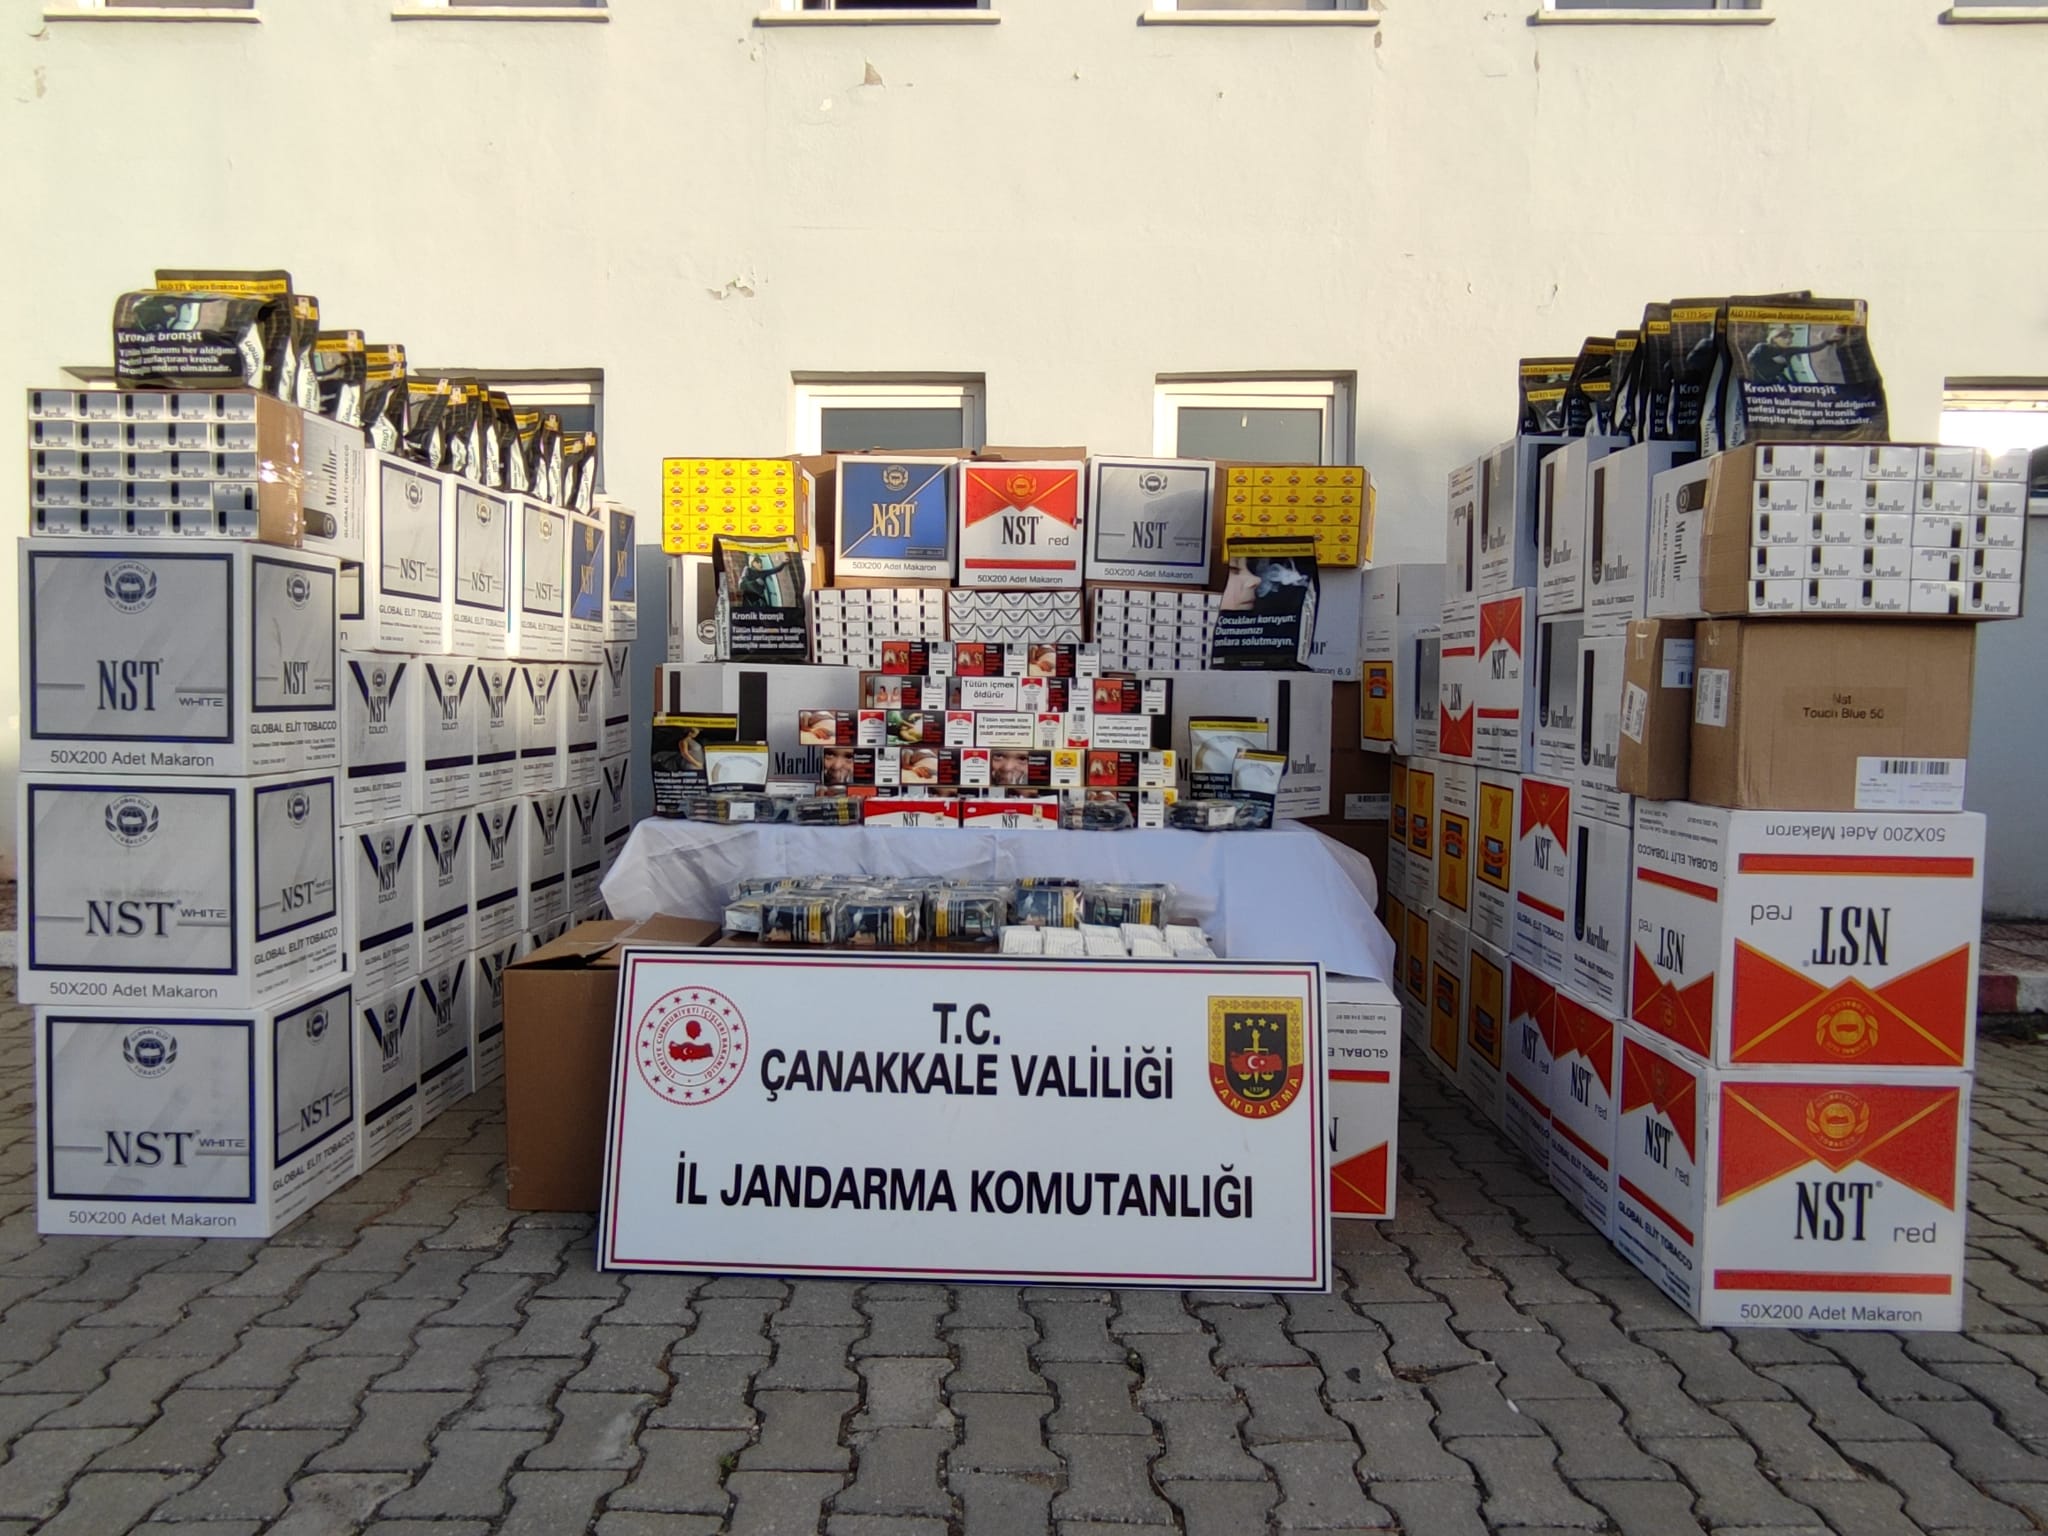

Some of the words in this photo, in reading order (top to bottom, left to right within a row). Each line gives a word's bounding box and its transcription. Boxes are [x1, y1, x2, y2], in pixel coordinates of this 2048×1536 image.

[158, 331, 202, 343] bronşit
[1744, 383, 1786, 393] Kronik
[1790, 384, 1836, 396] bronşit
[1746, 397, 1773, 405] Tütün
[1817, 400, 1832, 408] her
[1825, 408, 1856, 417] kronik
[872, 503, 915, 538] NST
[1002, 516, 1039, 545] NST
[1048, 536, 1069, 546] red
[1132, 521, 1168, 549] NST
[400, 558, 426, 582] NST
[852, 562, 882, 570] 50X200
[884, 562, 901, 570] Adet
[903, 562, 936, 571] Makaron
[1104, 568, 1135, 576] 50X200
[1137, 569, 1156, 578] Adet
[1158, 570, 1193, 579] Makaron
[471, 572, 492, 593] NST
[977, 575, 1008, 583] 50X200
[1009, 575, 1028, 584] Adet
[1030, 576, 1063, 584] Makaron
[535, 582, 553, 601] NST
[732, 612, 757, 620] Kronik
[1214, 638, 1240, 647] onlara
[1241, 636, 1294, 648] solutmayın.
[1492, 648, 1508, 680] NST
[97, 660, 160, 711] NST
[283, 661, 308, 695] NST
[964, 680, 988, 688] Tütün
[990, 680, 1015, 690] içmek
[179, 697, 224, 707] WHITE
[973, 690, 1004, 698] öldürür
[370, 696, 388, 722] NST
[442, 696, 458, 720] NST
[490, 696, 504, 718] NST
[534, 695, 546, 716] NST
[1842, 708, 1866, 718] Blue
[251, 723, 284, 734] GLOBAL
[302, 720, 337, 732] TOBACCO
[369, 725, 388, 734] touch
[442, 722, 458, 731] touch
[50, 750, 107, 764] 50X200
[112, 751, 146, 766] Adet
[151, 752, 214, 767] Makaron
[903, 813, 920, 826] NST
[1002, 816, 1019, 828] NST
[1766, 824, 1835, 840] Makaron
[1844, 825, 1876, 841] Adet
[1883, 827, 1946, 842] 50X200
[490, 837, 504, 861] NST
[1534, 835, 1552, 871] NST
[1637, 843, 1669, 860] TOBACCO
[439, 850, 453, 876] NST
[1687, 855, 1718, 872] GLOBAL
[378, 862, 398, 892] NST
[281, 880, 315, 913] NST
[378, 890, 398, 904] touch
[86, 900, 176, 938] NST
[180, 908, 227, 918] WHITE
[1751, 904, 1792, 925] red
[254, 946, 287, 965] GLOBAL
[306, 927, 338, 946] TOBACCO
[1812, 907, 1891, 966] NST
[1658, 926, 1685, 975] NST
[50, 982, 107, 996] 50X200
[112, 982, 146, 997] Adet
[152, 984, 218, 999] Makaron
[656, 1006, 700, 1044] CUMHURİYETİ
[932, 1003, 1000, 1046] T.C.
[382, 1028, 399, 1061] NST
[1522, 1023, 1539, 1066] NST
[656, 1048, 676, 1079] TÜRKİYE
[704, 1038, 728, 1079] BAKANLIĞI
[760, 1050, 998, 1102] ÇANAKKALE
[1012, 1045, 1174, 1100] VALİLİĞİ
[1570, 1061, 1592, 1108] NST
[1214, 1077, 1299, 1115] JANDARMA
[301, 1093, 333, 1132] NST
[1595, 1102, 1607, 1120] red
[103, 1130, 194, 1166] NST
[199, 1139, 247, 1148] WHITE
[1645, 1115, 1672, 1170] NST
[272, 1165, 305, 1191] GLOBAL
[676, 1152, 707, 1205] İL
[720, 1163, 958, 1213] JANDARMA
[970, 1163, 1254, 1219] KOMUTANLIĞI
[1582, 1162, 1608, 1194] TOBACCO
[1675, 1165, 1690, 1187] red
[69, 1210, 126, 1224] 50X200
[132, 1212, 166, 1226] Adet
[171, 1212, 236, 1227] Makaron
[1794, 1182, 1873, 1241] NST
[1618, 1200, 1644, 1229] GLOBAL
[1660, 1235, 1693, 1271] TOBACCO
[1893, 1223, 1936, 1243] red
[1740, 1304, 1803, 1320] 50X200
[1808, 1306, 1846, 1321] Adet
[1852, 1306, 1922, 1322] Makaron
